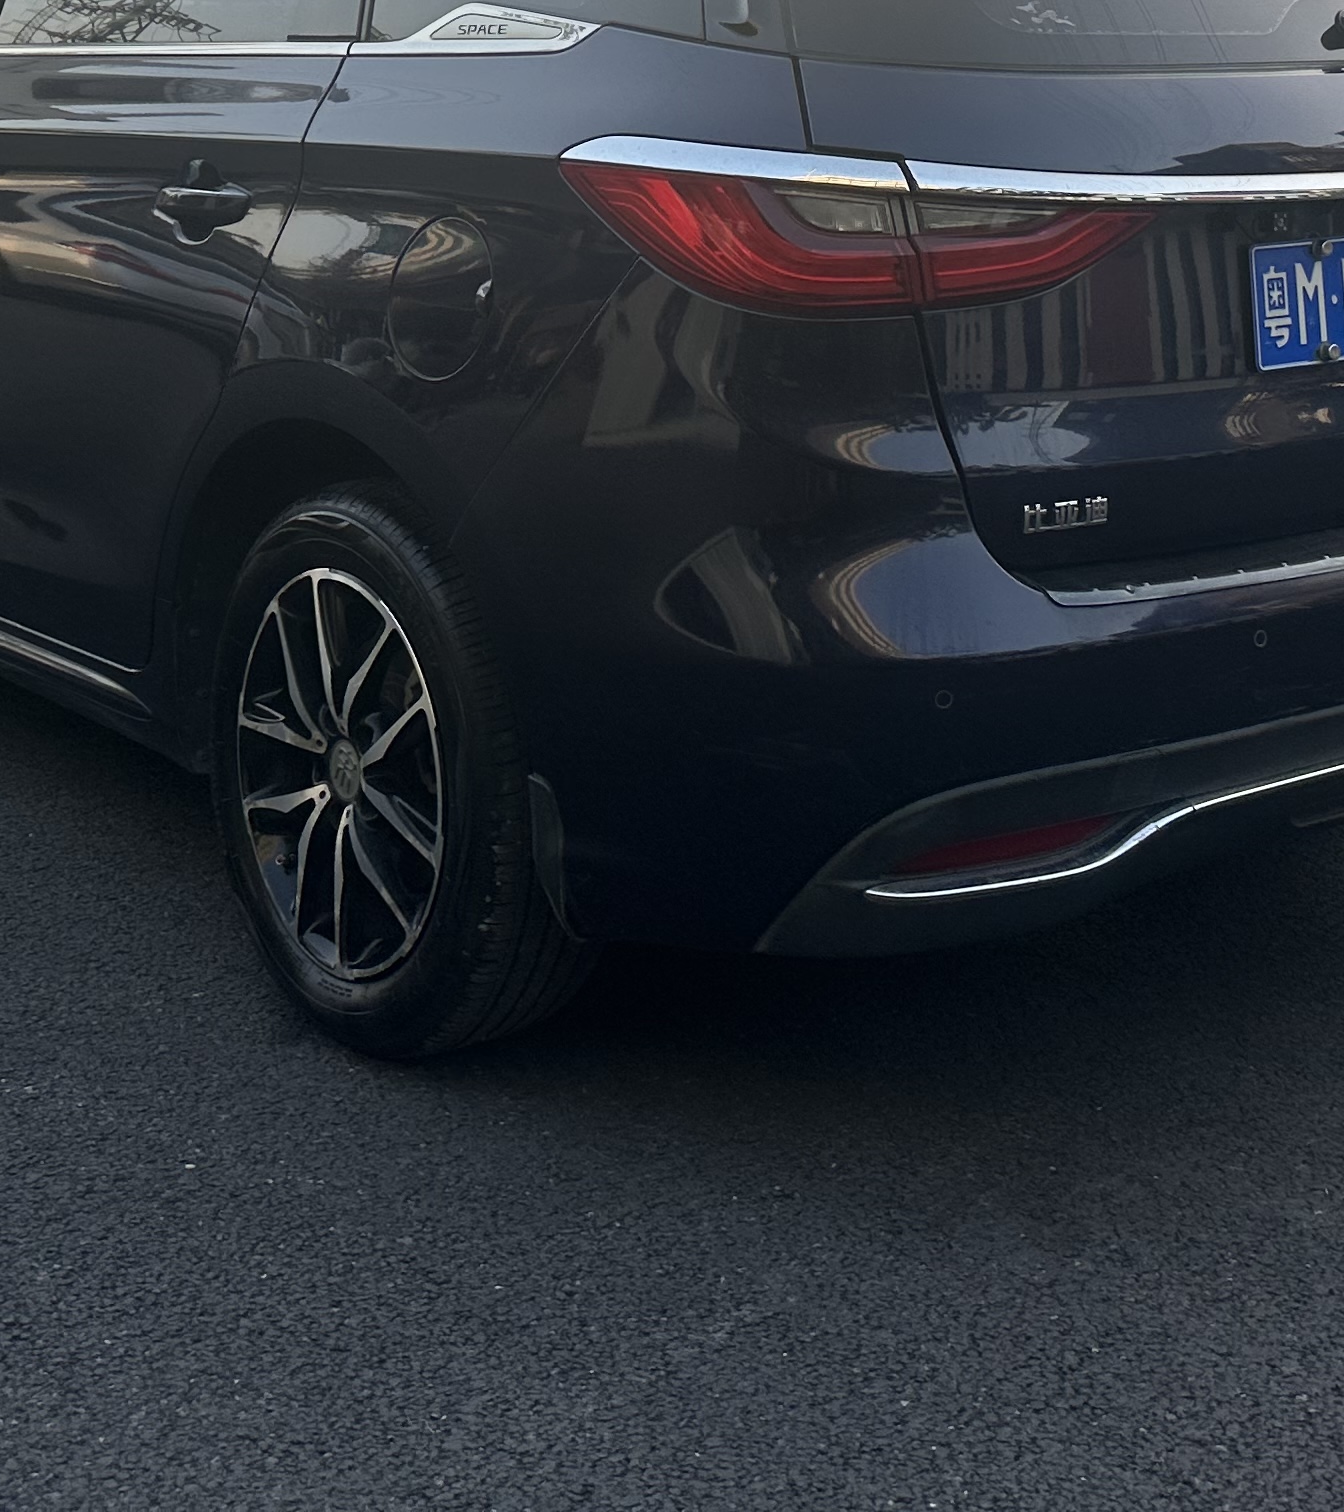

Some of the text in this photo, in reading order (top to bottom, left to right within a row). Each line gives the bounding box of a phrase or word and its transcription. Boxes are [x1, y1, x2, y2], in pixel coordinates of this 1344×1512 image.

[457, 24, 508, 35] SPACE
[1023, 496, 1108, 534] 比亚迪
